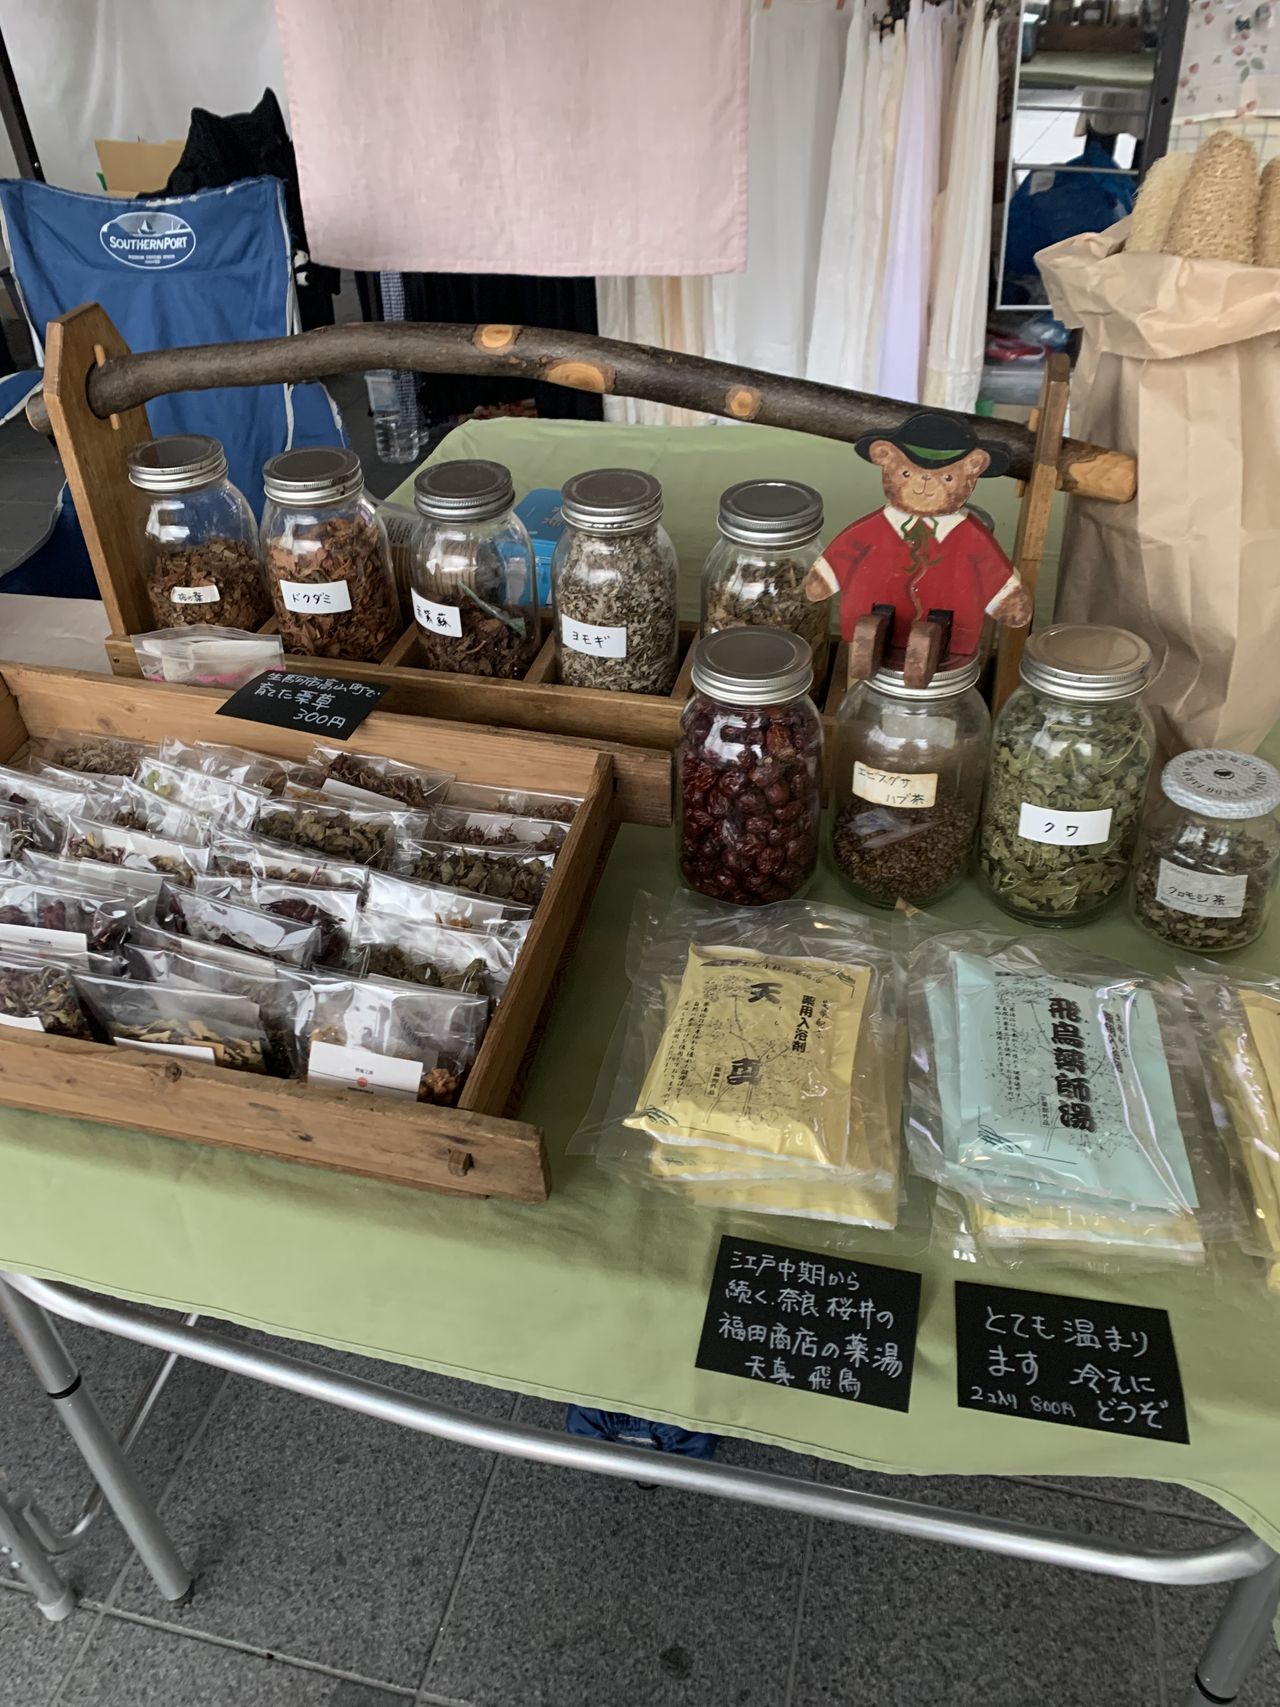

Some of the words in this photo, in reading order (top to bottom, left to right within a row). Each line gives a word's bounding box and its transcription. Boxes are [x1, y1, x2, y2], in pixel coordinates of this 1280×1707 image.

[109, 235, 188, 250] SOUTHERNPORT
[292, 592, 332, 604] ドクダミ
[572, 631, 610, 648] ヨモギ
[292, 708, 347, 729] 300円
[858, 767, 911, 788] エビスグサ
[1044, 822, 1080, 837] クワ
[1168, 886, 1226, 906] クロモジ茶
[791, 995, 816, 1053] 薬用入浴剤
[1048, 997, 1097, 1133] 飛鳥薬師湯
[730, 1250, 860, 1291] 江戸中期から
[826, 1297, 894, 1330] 桜井の
[718, 1311, 903, 1378] 福田商店の薬湯
[745, 1355, 796, 1386] 天真
[808, 1365, 861, 1400] 飛鳥
[988, 1345, 1039, 1385] ます
[1069, 1363, 1155, 1394] 冷えに
[1098, 1397, 1168, 1429] どうぞ
